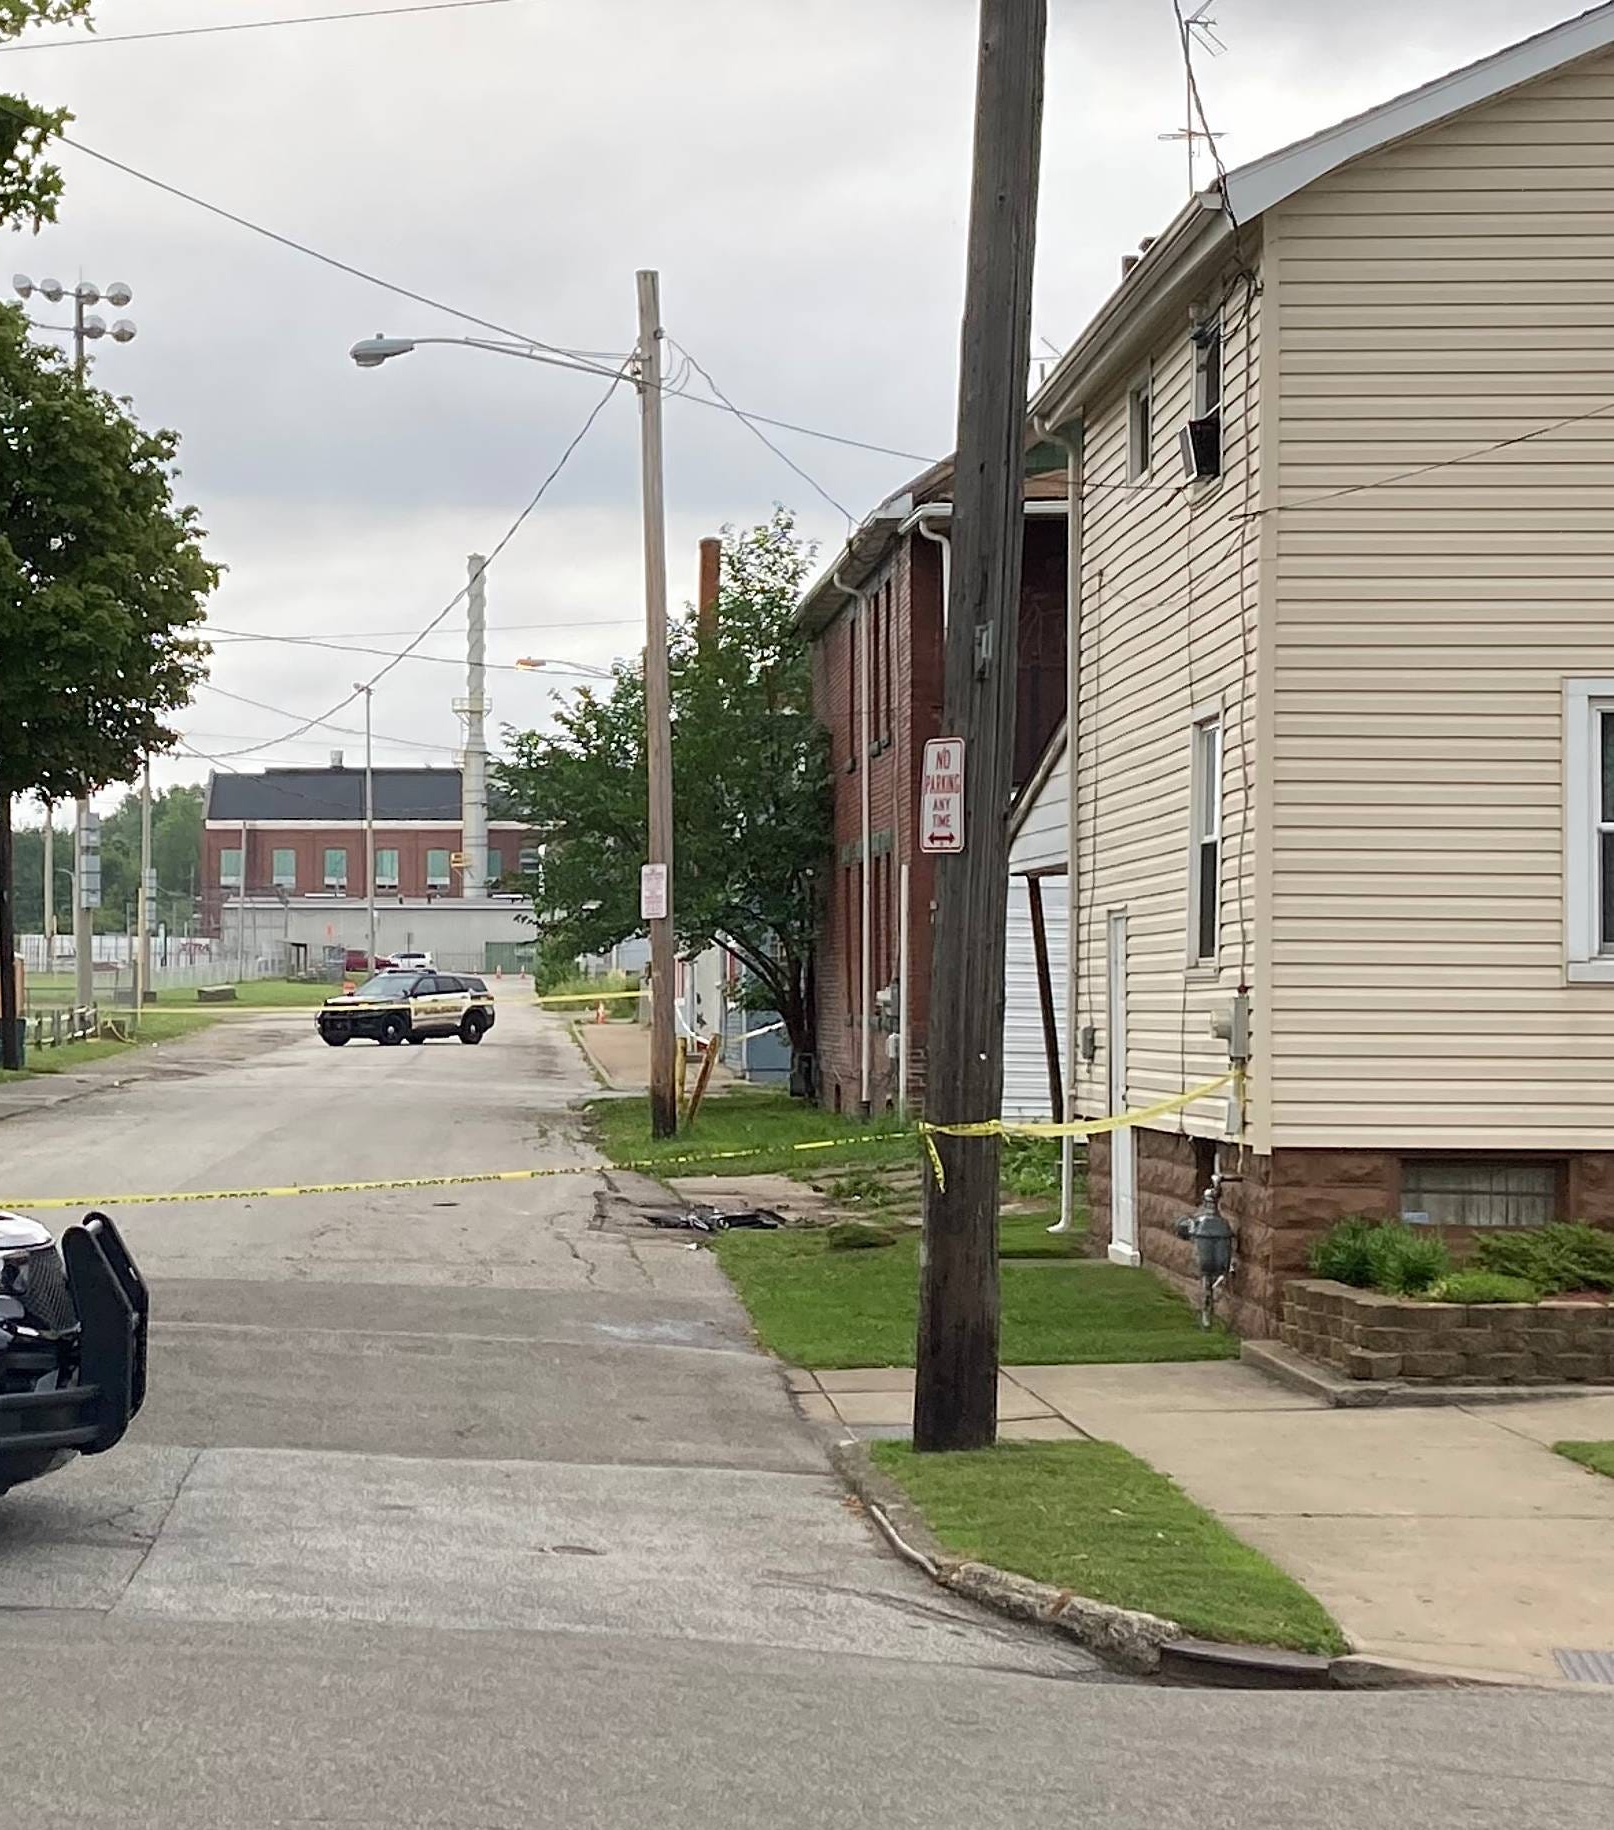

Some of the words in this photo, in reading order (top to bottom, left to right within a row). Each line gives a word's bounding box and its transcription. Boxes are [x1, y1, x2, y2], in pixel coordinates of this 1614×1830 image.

[935, 749, 952, 770] NO
[925, 773, 961, 794] PARKING
[932, 798, 952, 812] ANY
[932, 813, 952, 829] TIME
